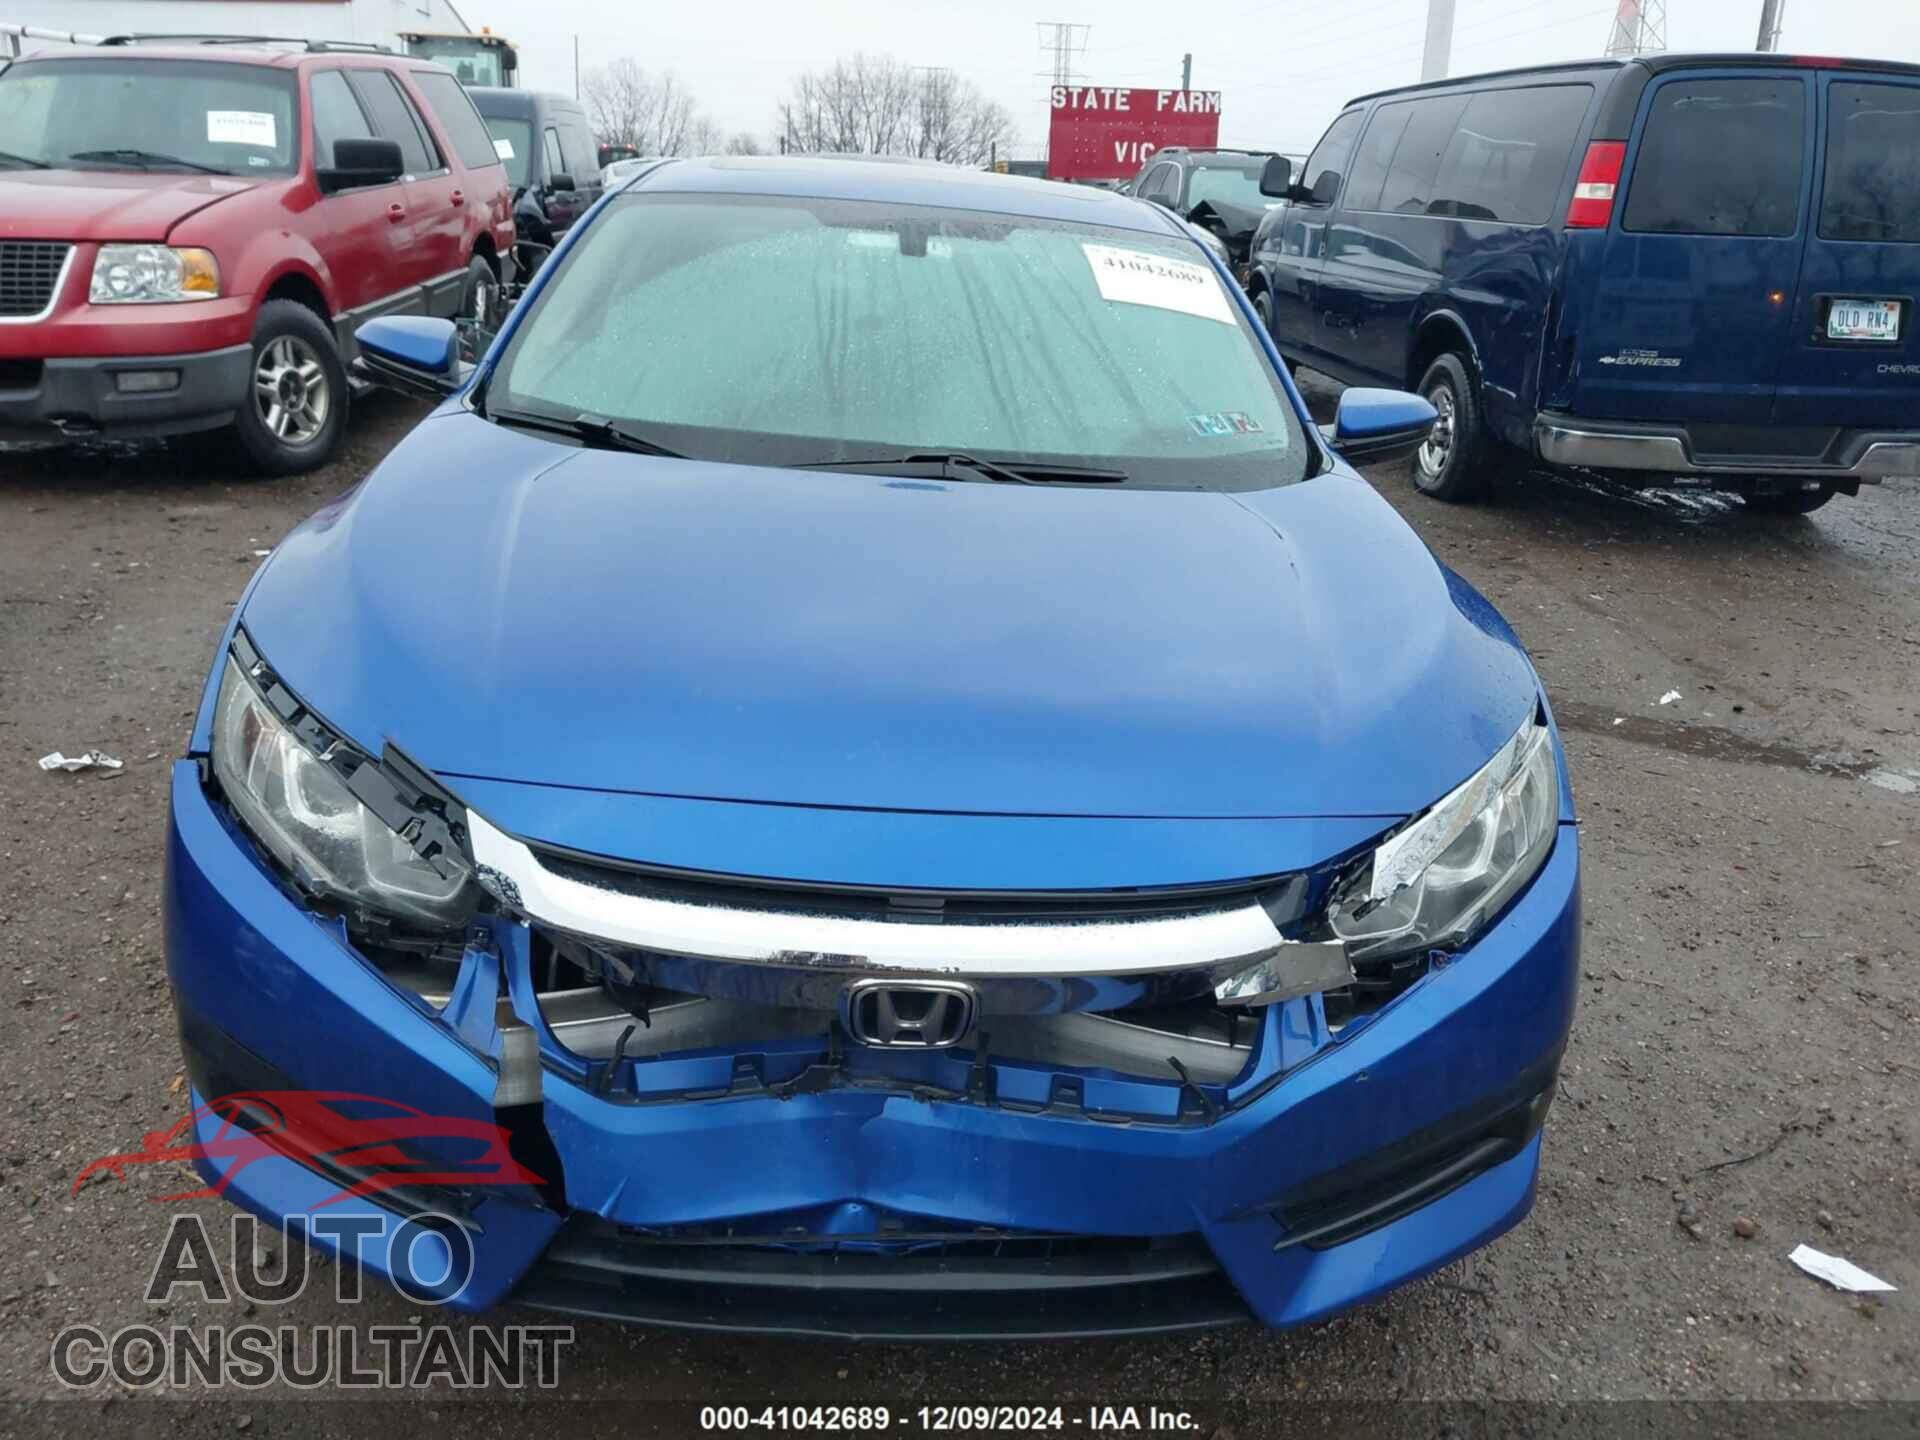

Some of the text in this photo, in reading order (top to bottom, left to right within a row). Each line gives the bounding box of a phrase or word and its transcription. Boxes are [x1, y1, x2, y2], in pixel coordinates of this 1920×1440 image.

[1051, 86, 1221, 114] STATE FARM
[1103, 257, 1204, 285] 41042689
[1615, 356, 1681, 367] EXPRESS
